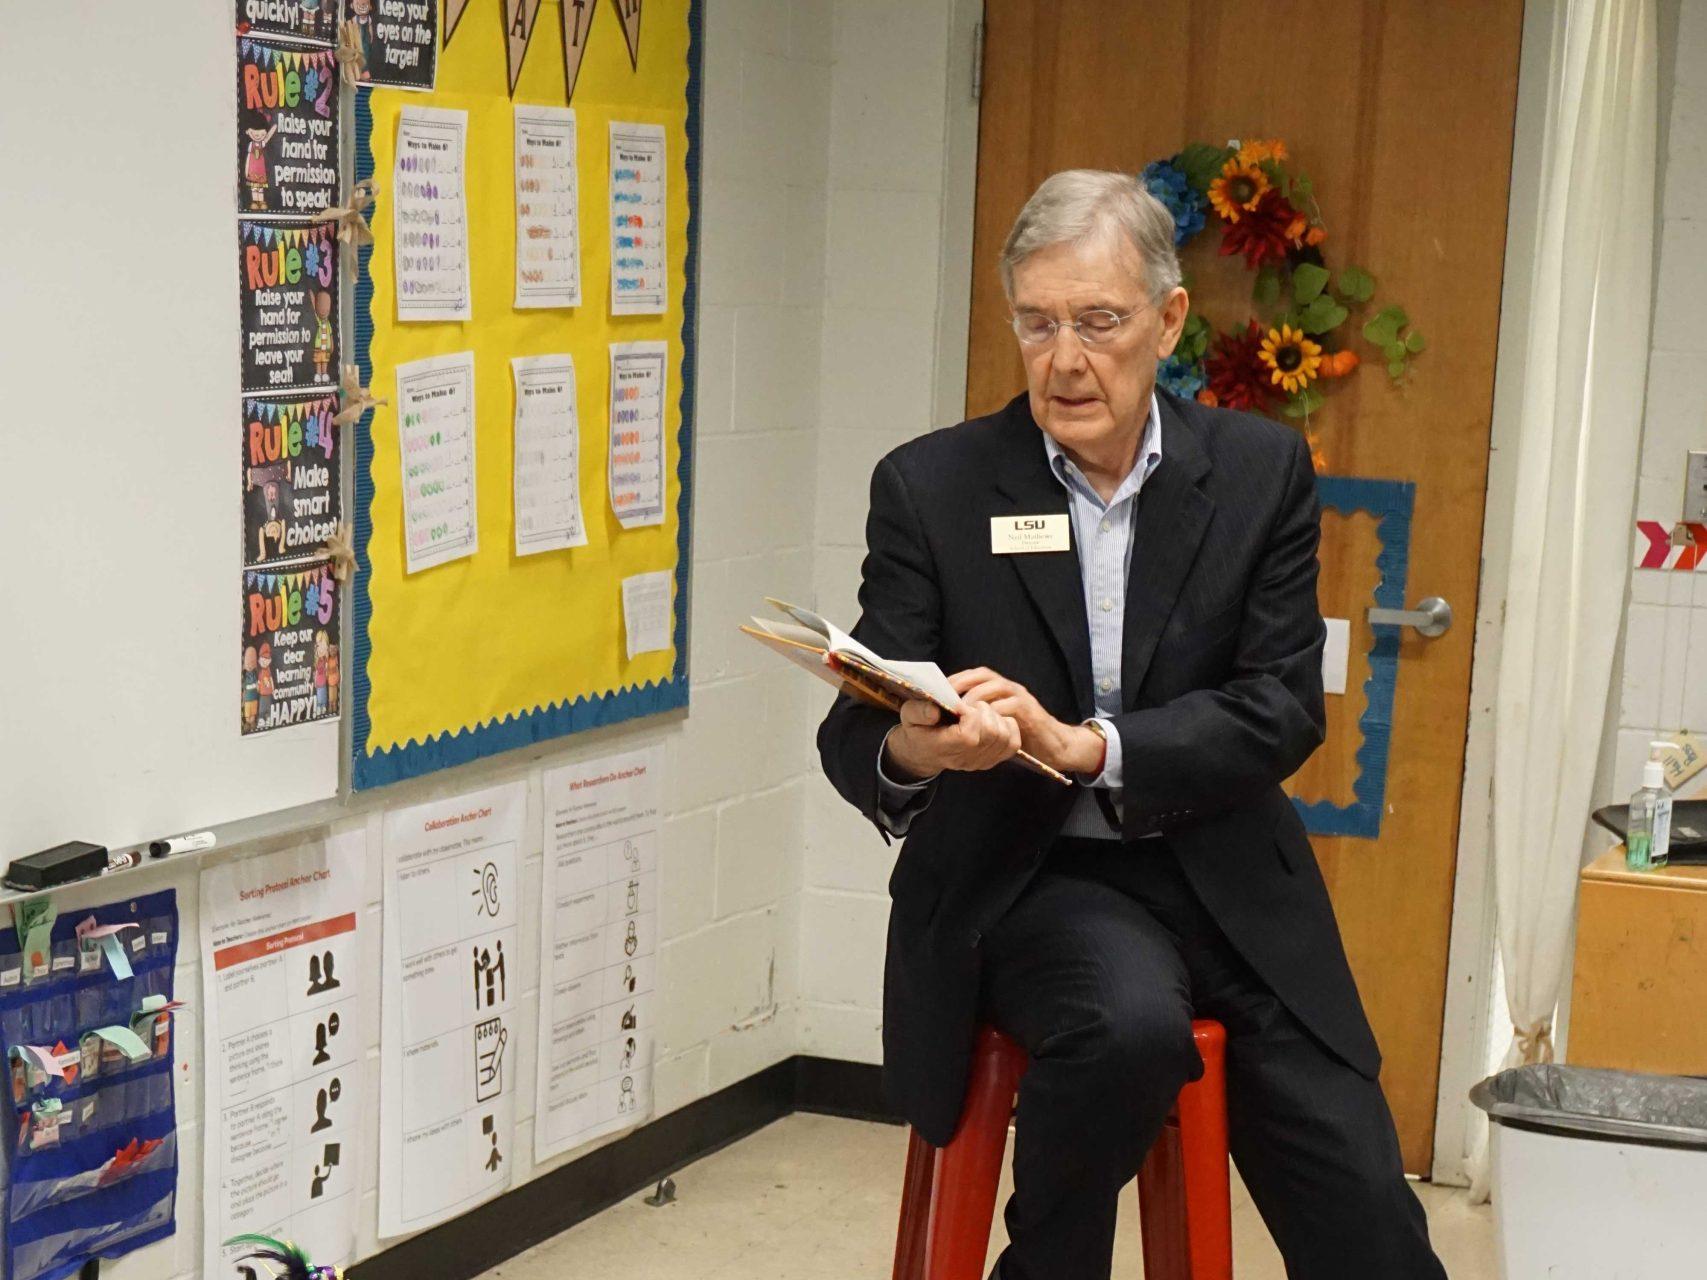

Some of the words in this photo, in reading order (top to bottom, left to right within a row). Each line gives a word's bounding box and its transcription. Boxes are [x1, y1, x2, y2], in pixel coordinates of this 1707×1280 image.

[246, 0, 299, 29] quickly!
[379, 0, 405, 22] Keep
[407, 4, 428, 23] your
[377, 23, 400, 44] eyes
[402, 26, 413, 42] on
[415, 24, 431, 45] the
[385, 44, 419, 69] target!
[244, 62, 300, 109] Rule
[304, 65, 332, 118] #2
[278, 113, 306, 134] Raise
[308, 120, 332, 139] your
[282, 137, 311, 159] hand
[313, 139, 328, 160] for
[274, 163, 335, 186] permission
[281, 187, 293, 206] to
[296, 188, 331, 212] speak!
[246, 240, 301, 290] Rule
[306, 240, 332, 288] #3
[255, 289, 281, 306] Raise
[283, 291, 304, 308] your
[260, 309, 284, 326] hand
[287, 308, 300, 324] for
[249, 328, 299, 349] permission
[302, 327, 311, 343] to
[255, 349, 283, 365] leave
[284, 350, 304, 367] your
[269, 367, 293, 383] seat!
[249, 415, 302, 465] Rule
[305, 411, 333, 459] #4
[294, 464, 329, 490] Make
[294, 490, 330, 517] smart
[1015, 520, 1045, 530] LSU
[249, 585, 301, 636] Rule
[305, 579, 334, 625] #5
[274, 631, 298, 647] Keep
[299, 629, 313, 642] our
[276, 665, 311, 683] learning
[274, 682, 314, 700] community
[270, 695, 317, 727] HAPPY!
[478, 807, 491, 818] Chart
[240, 889, 264, 901] Sorting
[265, 880, 288, 893] Protocol
[290, 874, 312, 886] Anchor
[313, 869, 331, 881] Chart
